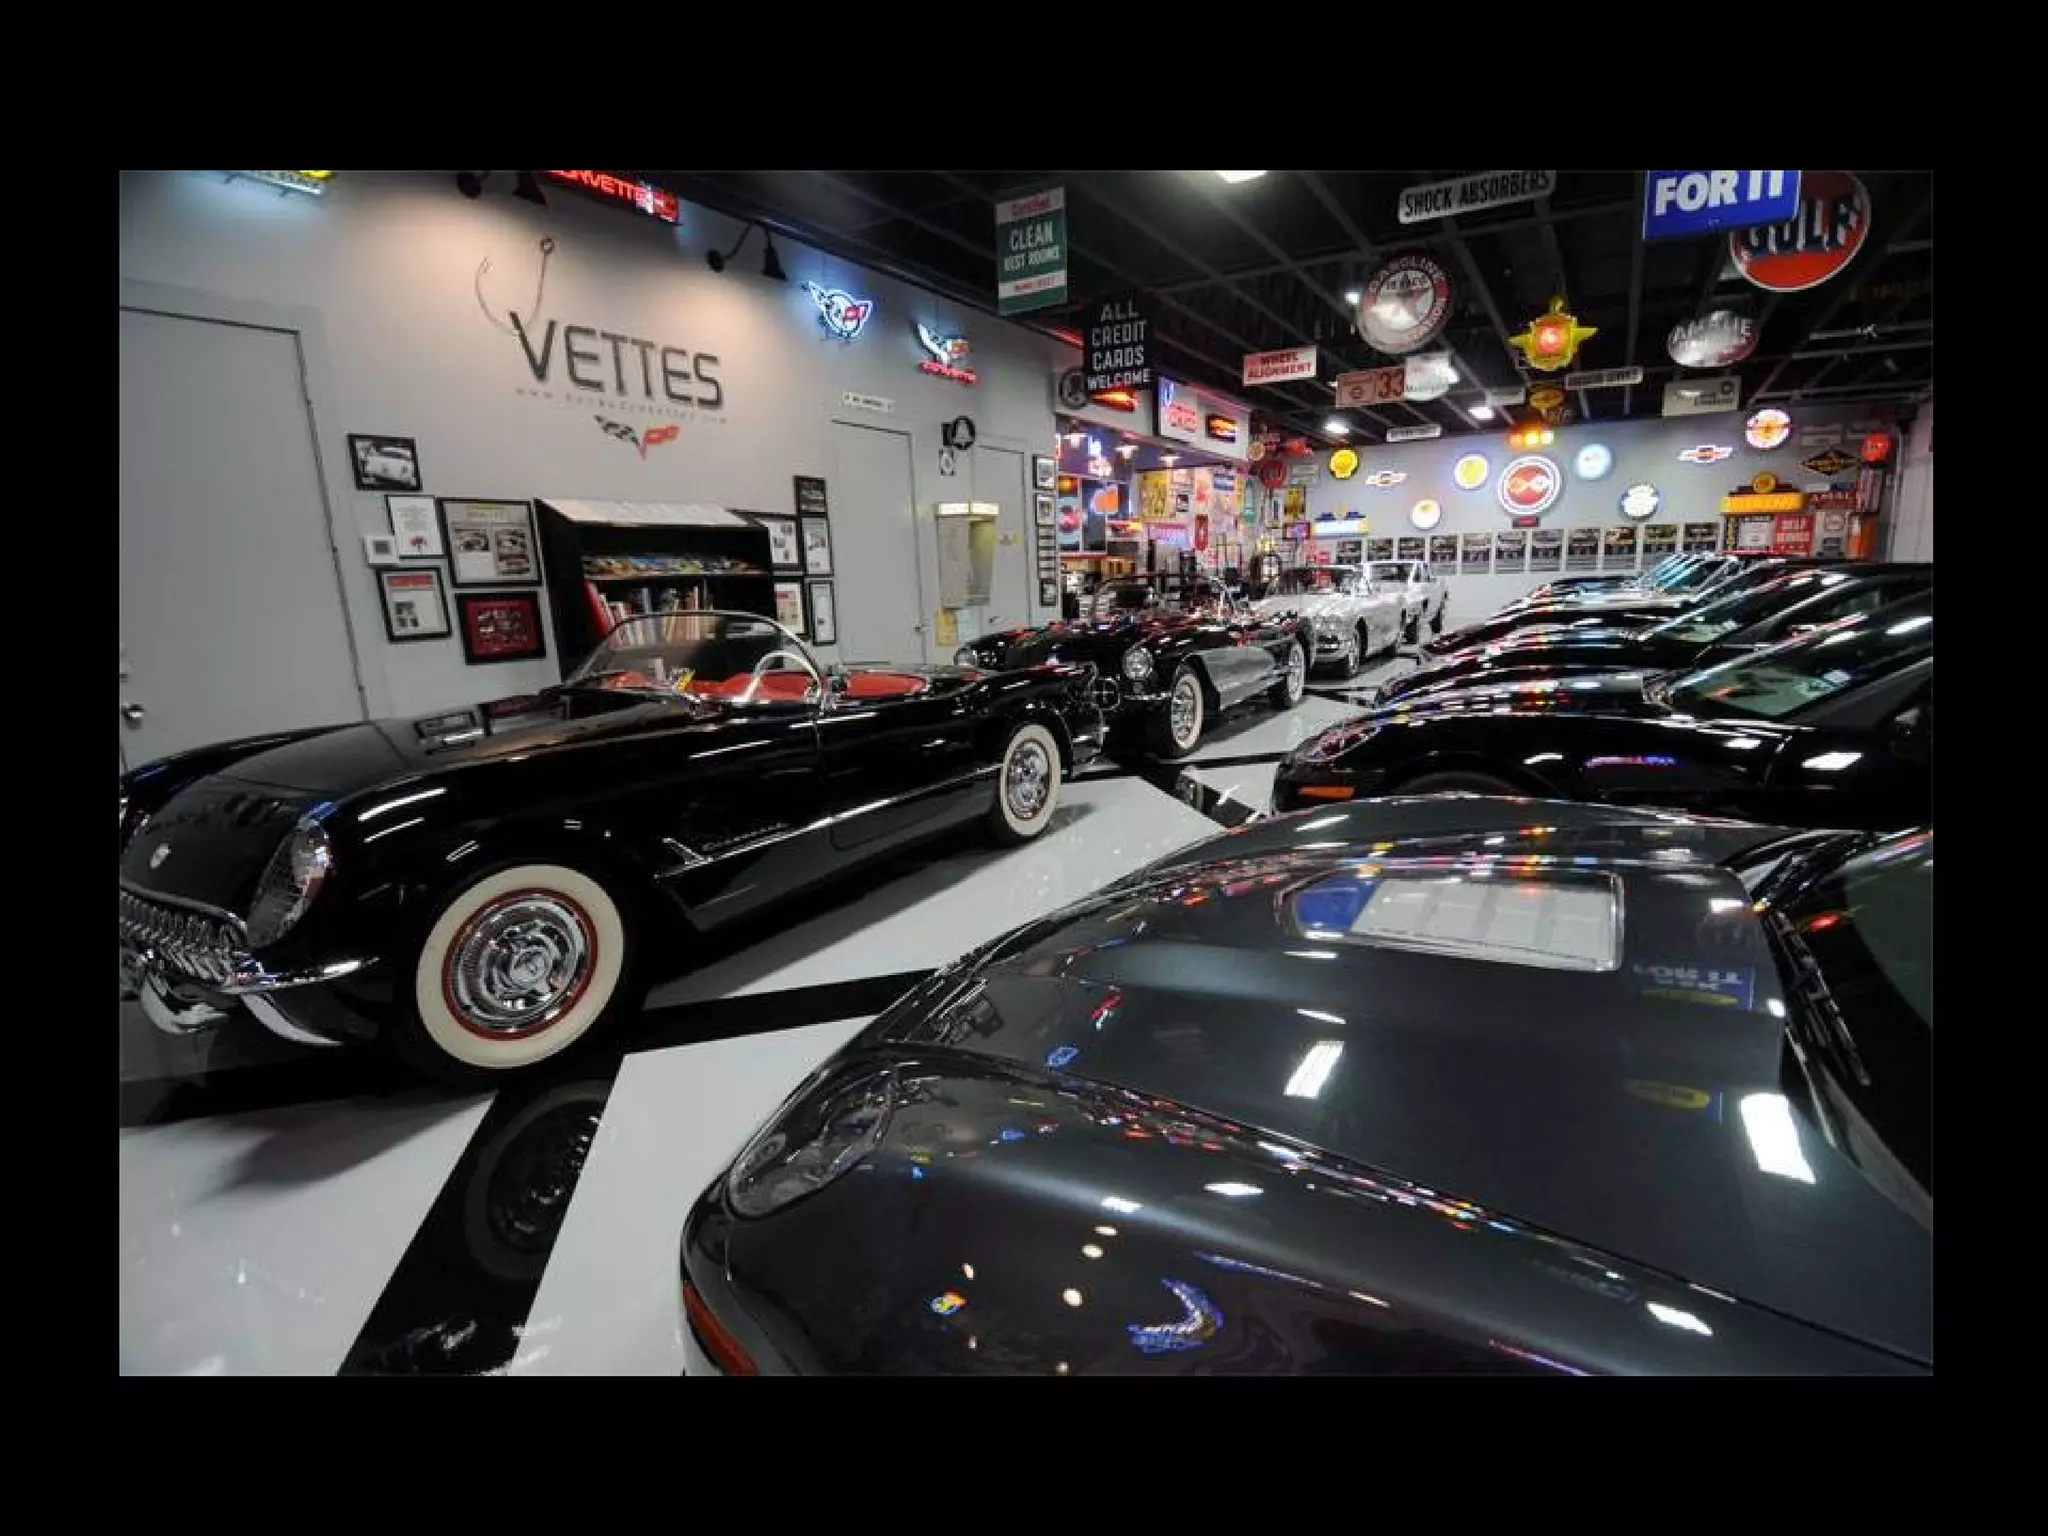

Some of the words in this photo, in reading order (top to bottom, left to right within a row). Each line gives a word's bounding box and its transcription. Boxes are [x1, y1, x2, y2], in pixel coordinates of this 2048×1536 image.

[1405, 186, 1452, 218] SHOCK
[1655, 170, 1739, 216] FOR
[1009, 221, 1053, 252] CLEAN
[1100, 299, 1139, 322] ALL
[1091, 320, 1147, 347] CREDIT
[509, 310, 723, 409] VETTES
[1091, 345, 1145, 371] CARDS
[1087, 368, 1150, 391] WELCOME
